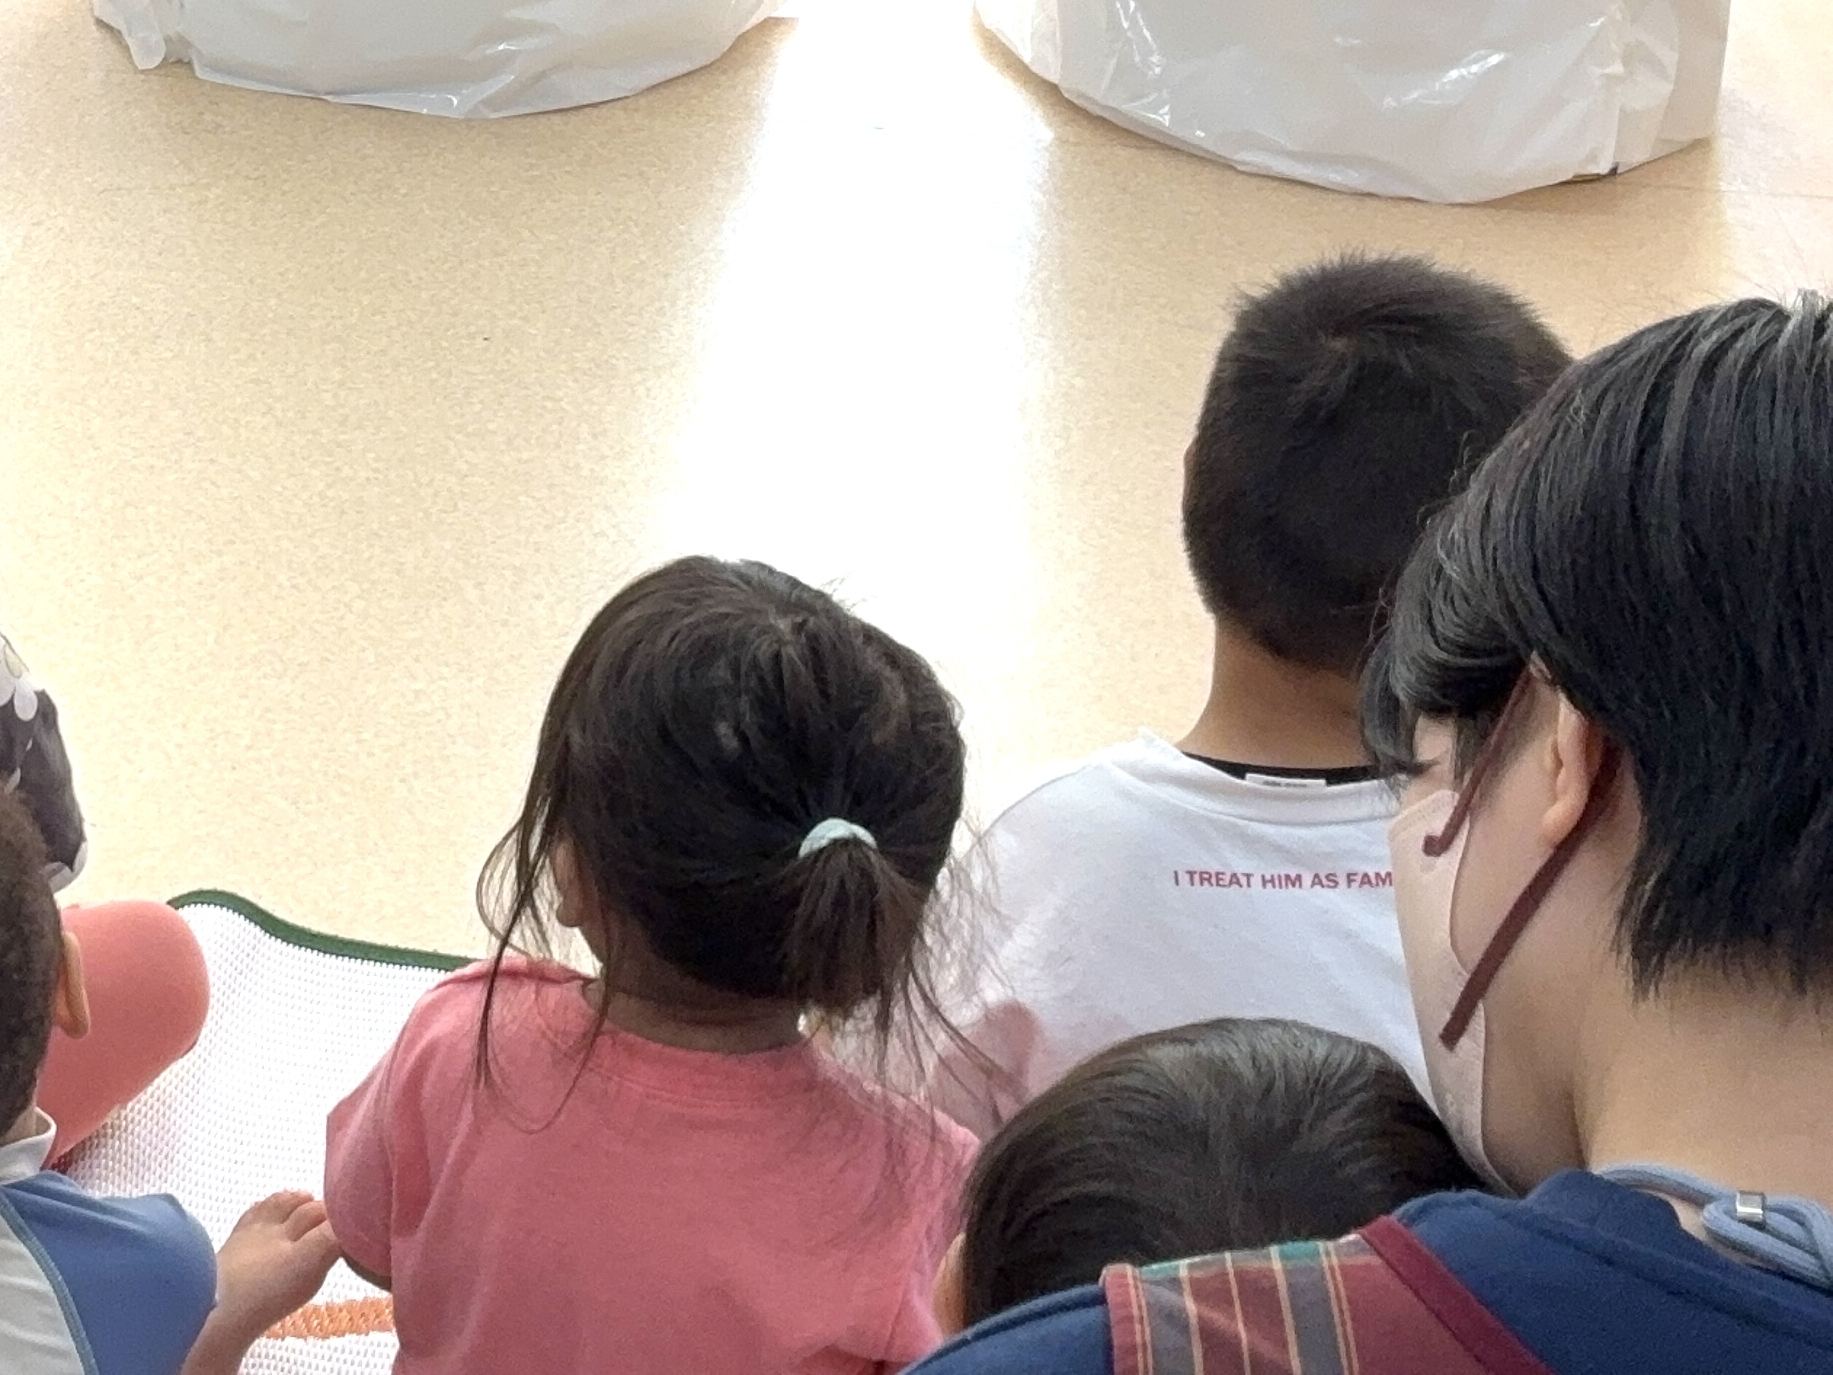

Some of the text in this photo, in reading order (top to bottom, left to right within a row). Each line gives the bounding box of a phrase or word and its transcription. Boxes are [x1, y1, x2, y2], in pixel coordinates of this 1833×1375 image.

[1173, 870, 1180, 887] I
[1185, 870, 1255, 888] TREAT
[1261, 873, 1303, 890] HIM
[1310, 873, 1340, 889] AS
